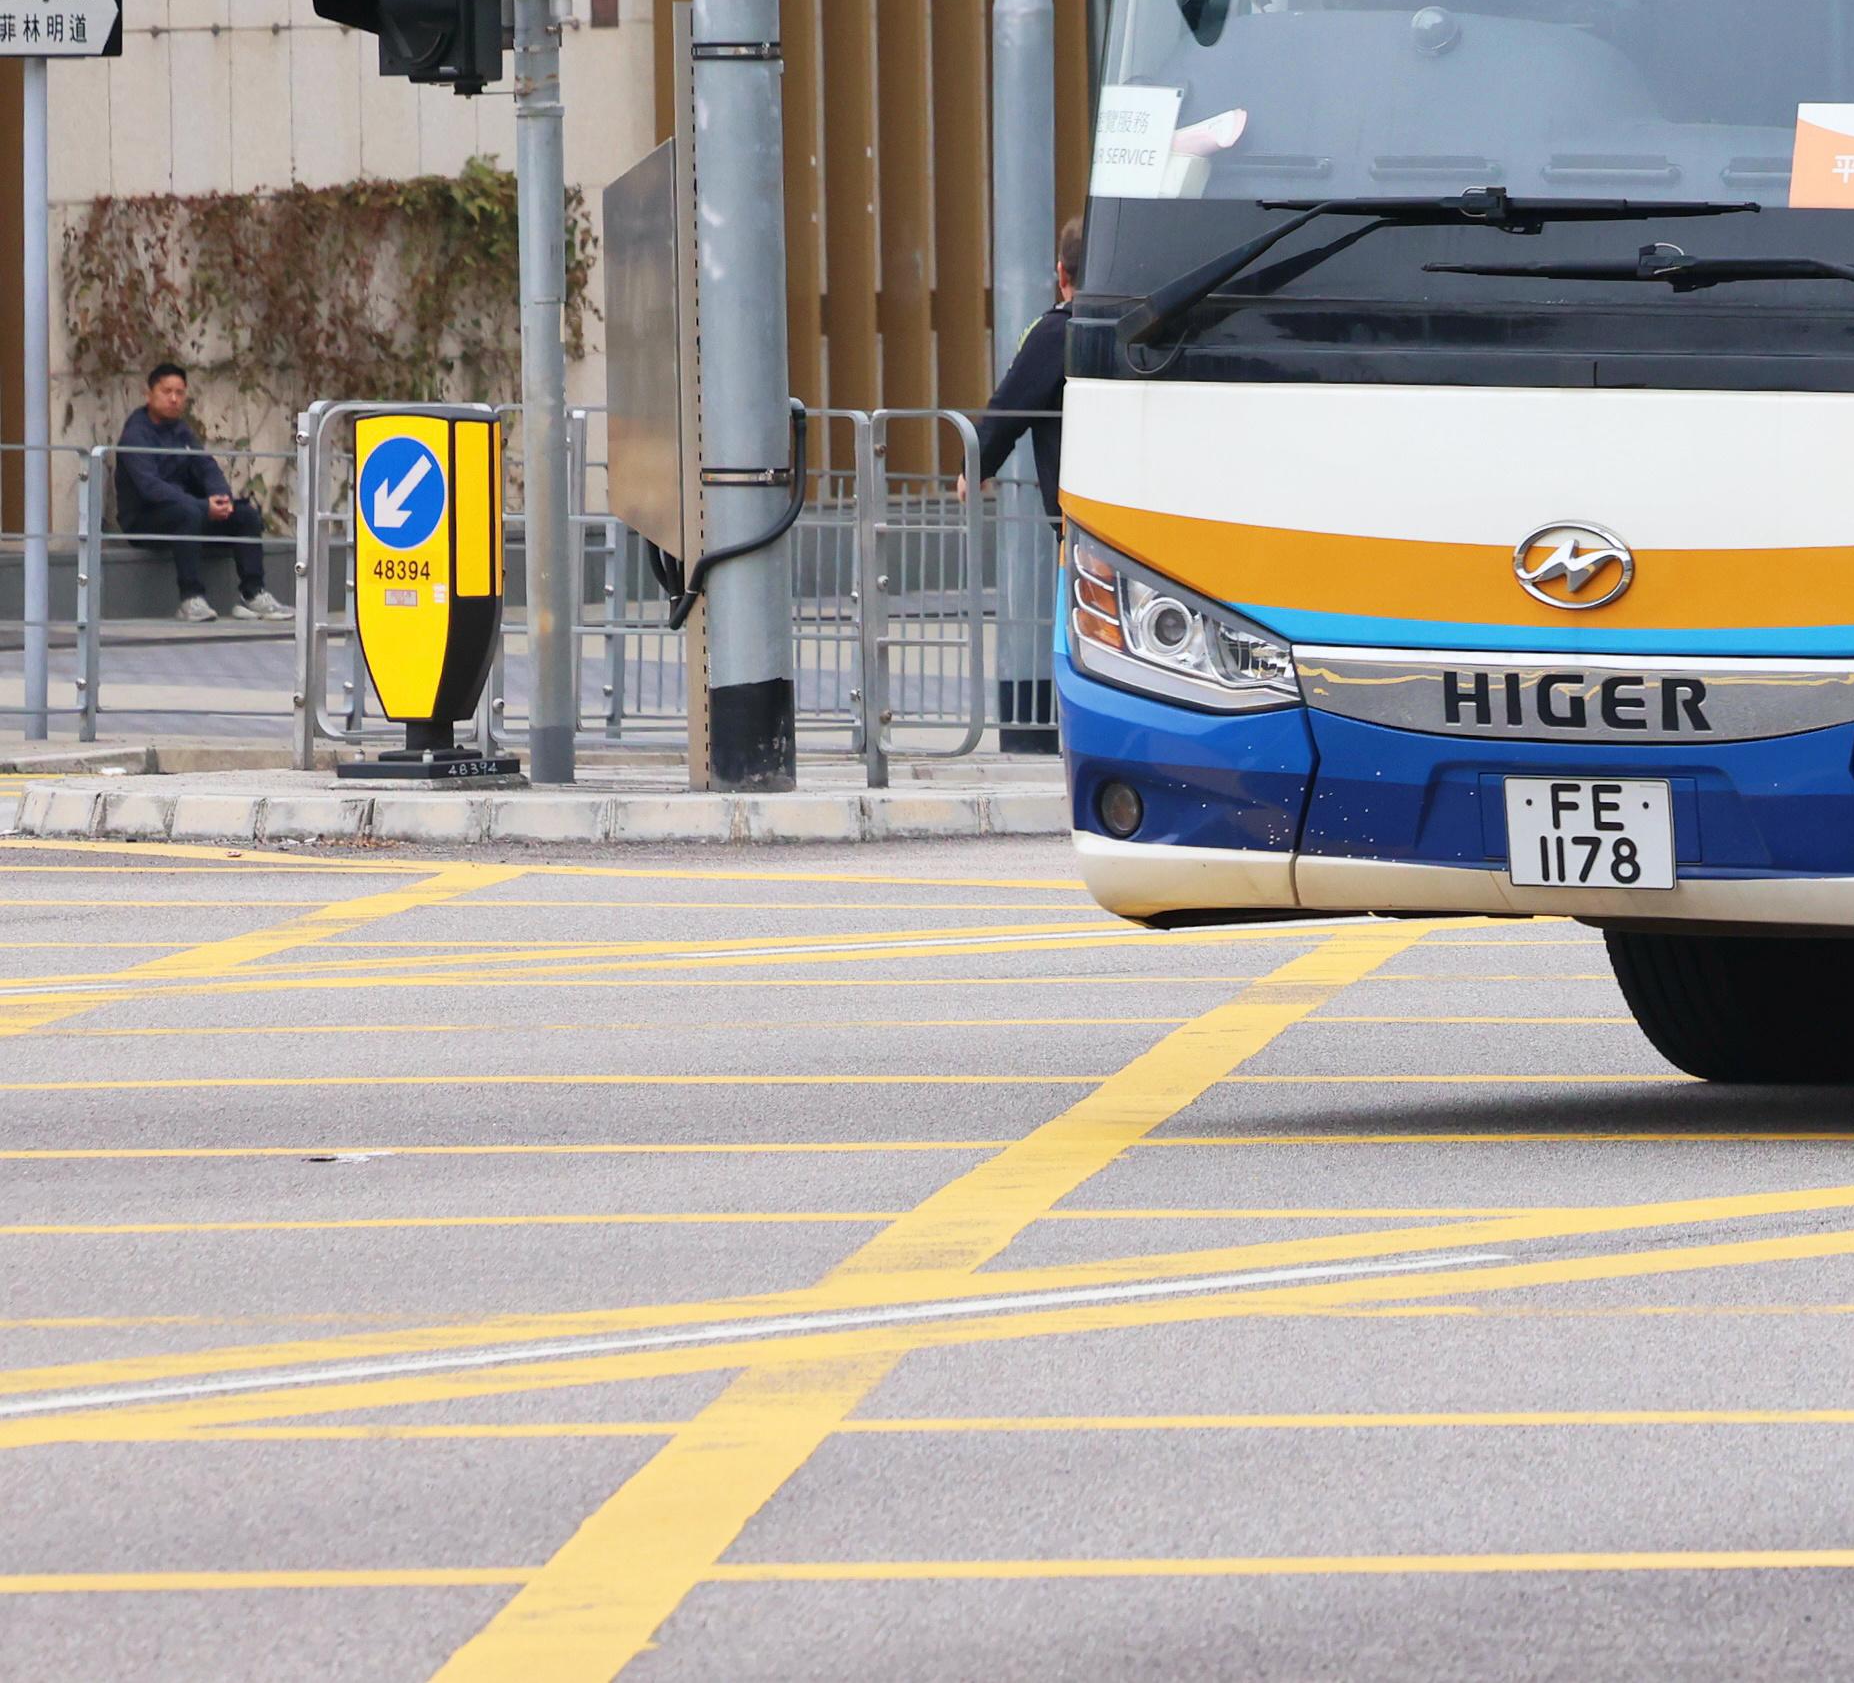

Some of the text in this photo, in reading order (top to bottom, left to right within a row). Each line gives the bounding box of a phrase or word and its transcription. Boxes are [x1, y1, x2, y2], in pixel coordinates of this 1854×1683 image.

[0, 13, 87, 43] 菲林明道
[1106, 148, 1157, 166] SERVICE
[374, 559, 431, 581] 48394
[1443, 671, 1713, 733] HIGER
[447, 761, 498, 776] 48394
[1550, 783, 1625, 831] FE
[1540, 835, 1641, 884] 1178
